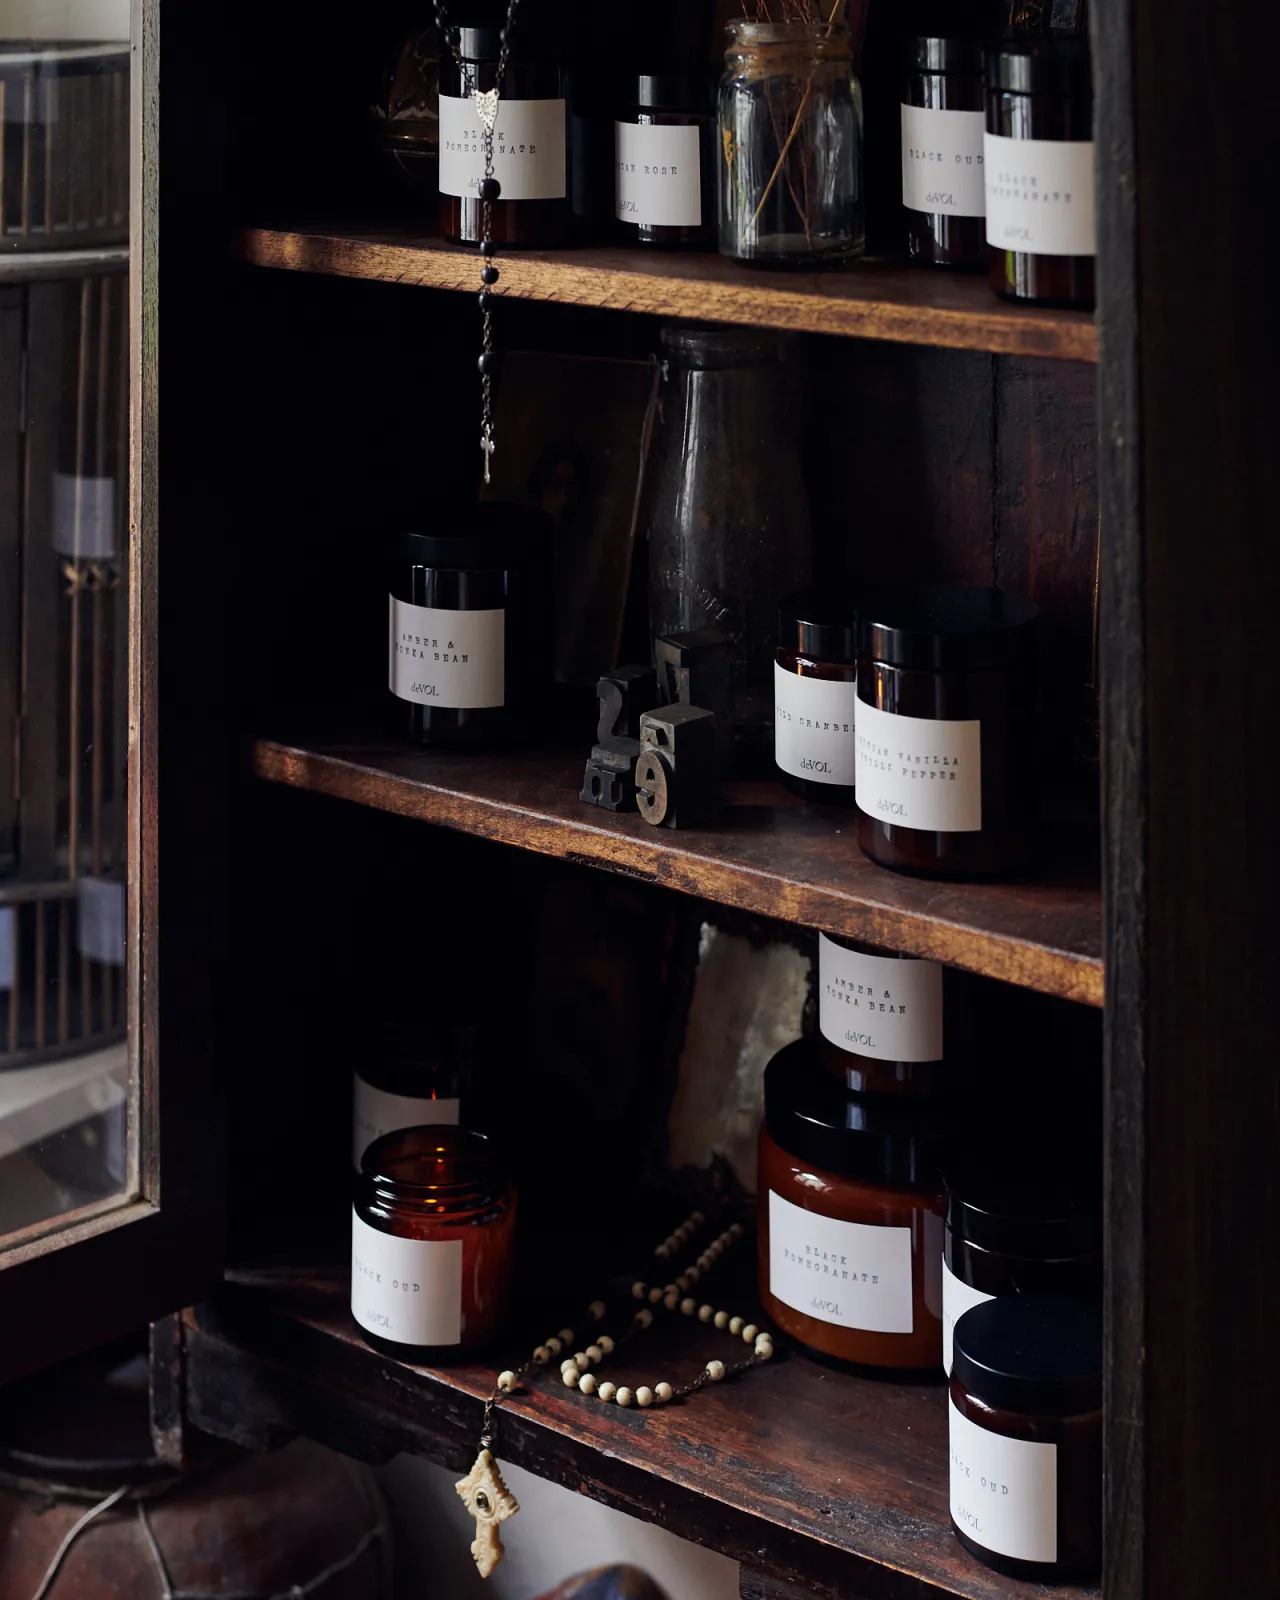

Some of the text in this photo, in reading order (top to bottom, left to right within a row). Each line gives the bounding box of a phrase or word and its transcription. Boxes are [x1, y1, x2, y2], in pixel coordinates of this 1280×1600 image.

[463, 130, 505, 141] BLAK
[955, 155, 984, 165] OUD
[644, 165, 678, 175] ROSE
[402, 633, 455, 649] AMBER &
[433, 652, 469, 663] BEAN
[410, 681, 440, 697] deVOL
[800, 757, 832, 774] deVOL
[897, 751, 960, 766] VANILLA
[902, 767, 957, 781] PEPPER
[876, 798, 908, 817] deVOL
[834, 976, 891, 999] AMBER &
[826, 984, 907, 1015] TONKA BEAN
[844, 1029, 876, 1048] deVOL
[805, 1244, 848, 1266] BLACK
[784, 1247, 880, 1285] POMEGRANATE
[392, 1279, 421, 1293] OUD
[811, 1296, 844, 1317] deVOL
[980, 1476, 1009, 1496] OUD
